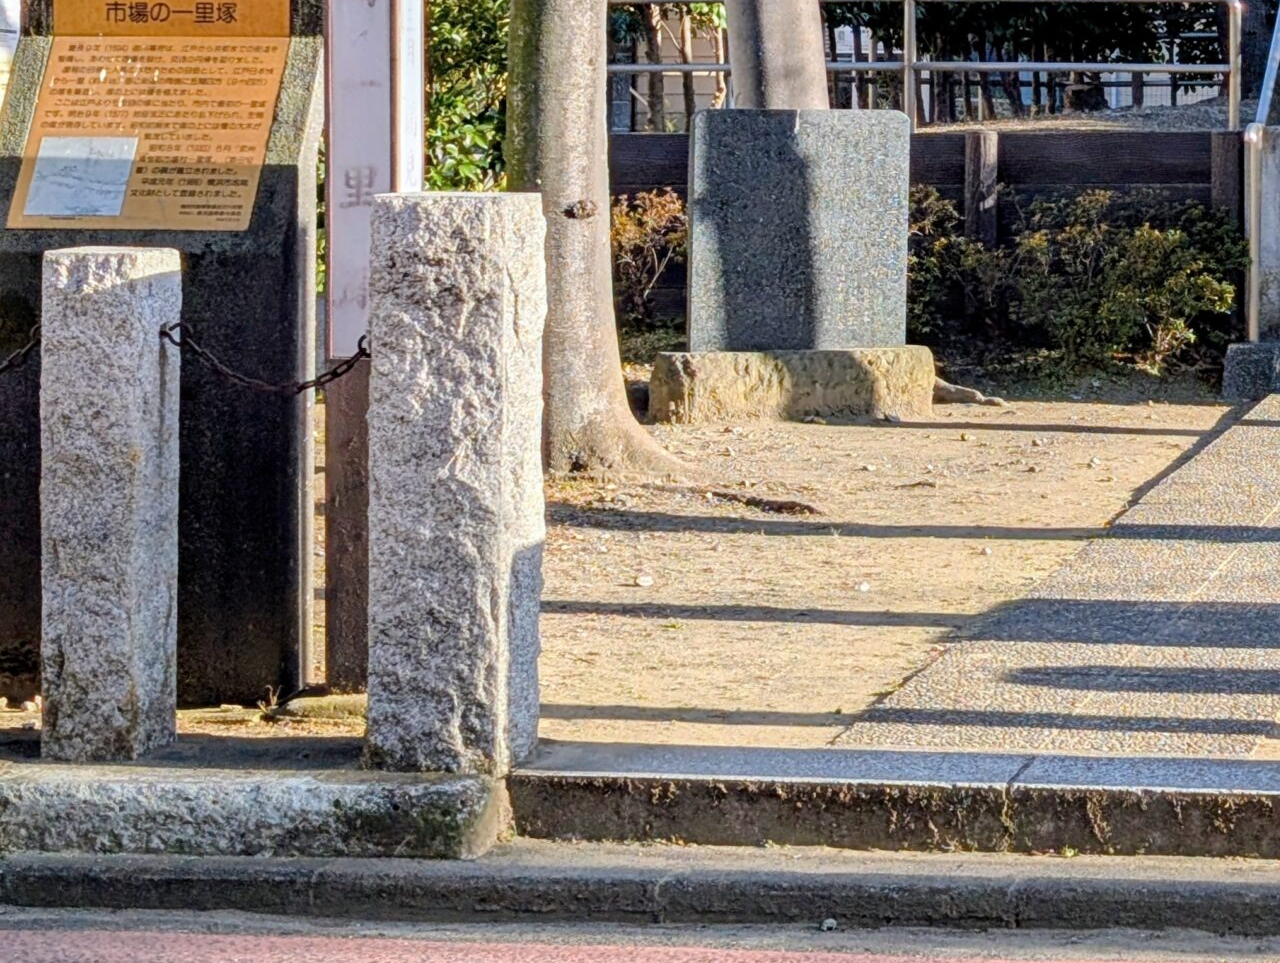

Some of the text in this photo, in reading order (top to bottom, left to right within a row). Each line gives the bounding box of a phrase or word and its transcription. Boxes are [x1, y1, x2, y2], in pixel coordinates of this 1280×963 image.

[105, 1, 238, 24] 市場の一里塚
